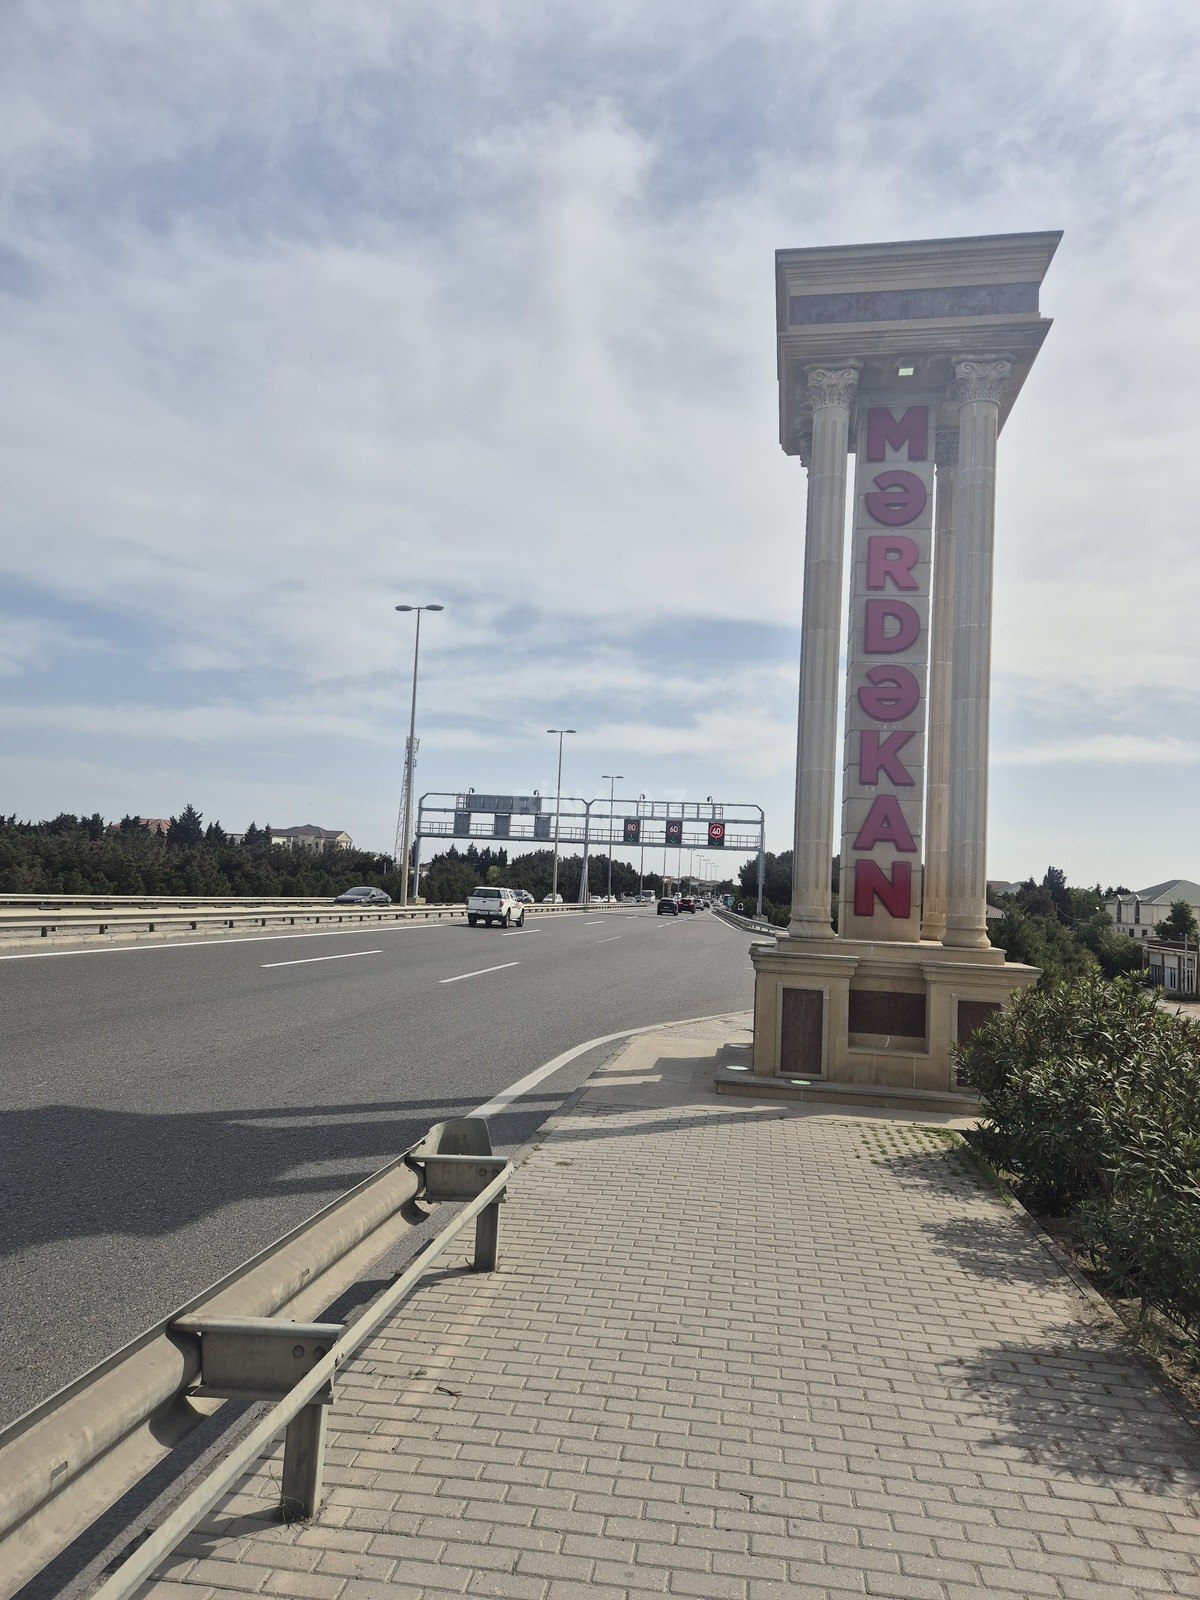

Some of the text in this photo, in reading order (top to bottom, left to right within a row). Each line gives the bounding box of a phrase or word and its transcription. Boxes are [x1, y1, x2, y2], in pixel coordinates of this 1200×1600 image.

[852, 406, 929, 919] MƏRDƏKAN
[627, 823, 636, 832] 80
[669, 825, 679, 833] 60
[712, 827, 721, 835] 40
